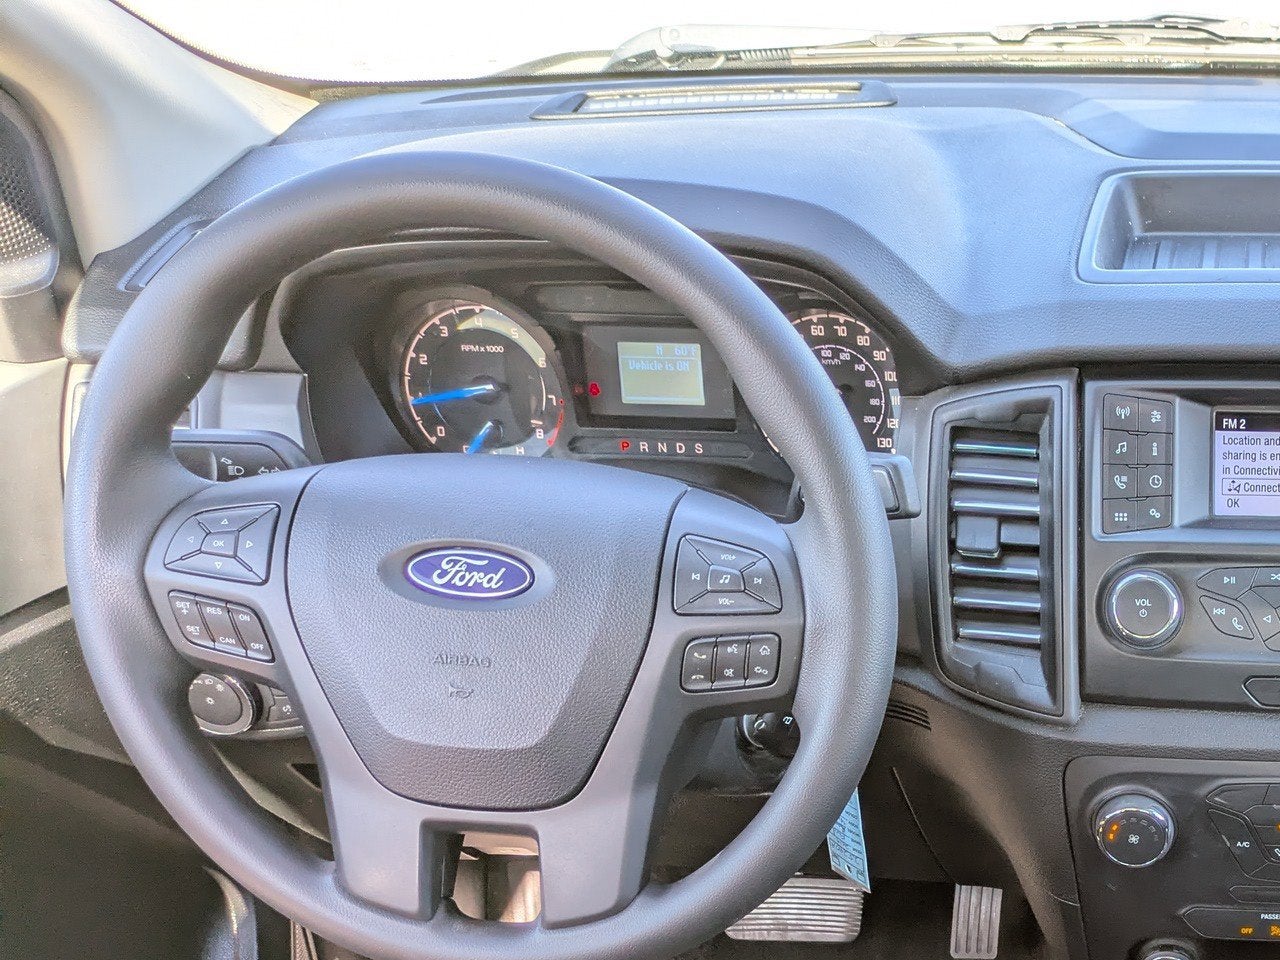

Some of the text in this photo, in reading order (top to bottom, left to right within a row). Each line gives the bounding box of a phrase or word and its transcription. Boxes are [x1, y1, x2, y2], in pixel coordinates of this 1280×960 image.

[440, 327, 448, 337] 3
[511, 328, 519, 338] 5
[811, 325, 824, 336] 60
[833, 326, 847, 337] 70
[857, 335, 870, 346] 80
[420, 354, 428, 365] 2
[873, 351, 887, 361] 90
[863, 415, 877, 424] 200
[1222, 418, 1246, 430] FM 2
[536, 429, 544, 439] 8
[877, 438, 892, 448] 130
[1222, 435, 1261, 446] Location
[1264, 436, 1280, 447] and
[515, 446, 525, 455] H
[620, 441, 704, 454] P R N D S
[1222, 451, 1257, 462] sharing
[1259, 451, 1267, 461] is
[1222, 465, 1231, 475] in
[1226, 499, 1240, 509] OK
[433, 556, 507, 589] Ford
[175, 601, 190, 609] SET
[1135, 599, 1152, 607] VOL
[206, 606, 223, 615] RES
[238, 614, 251, 622] ON
[186, 625, 200, 633] SET
[219, 636, 236, 645] CAN
[250, 642, 264, 650] OFF
[1240, 927, 1254, 935] OFF
